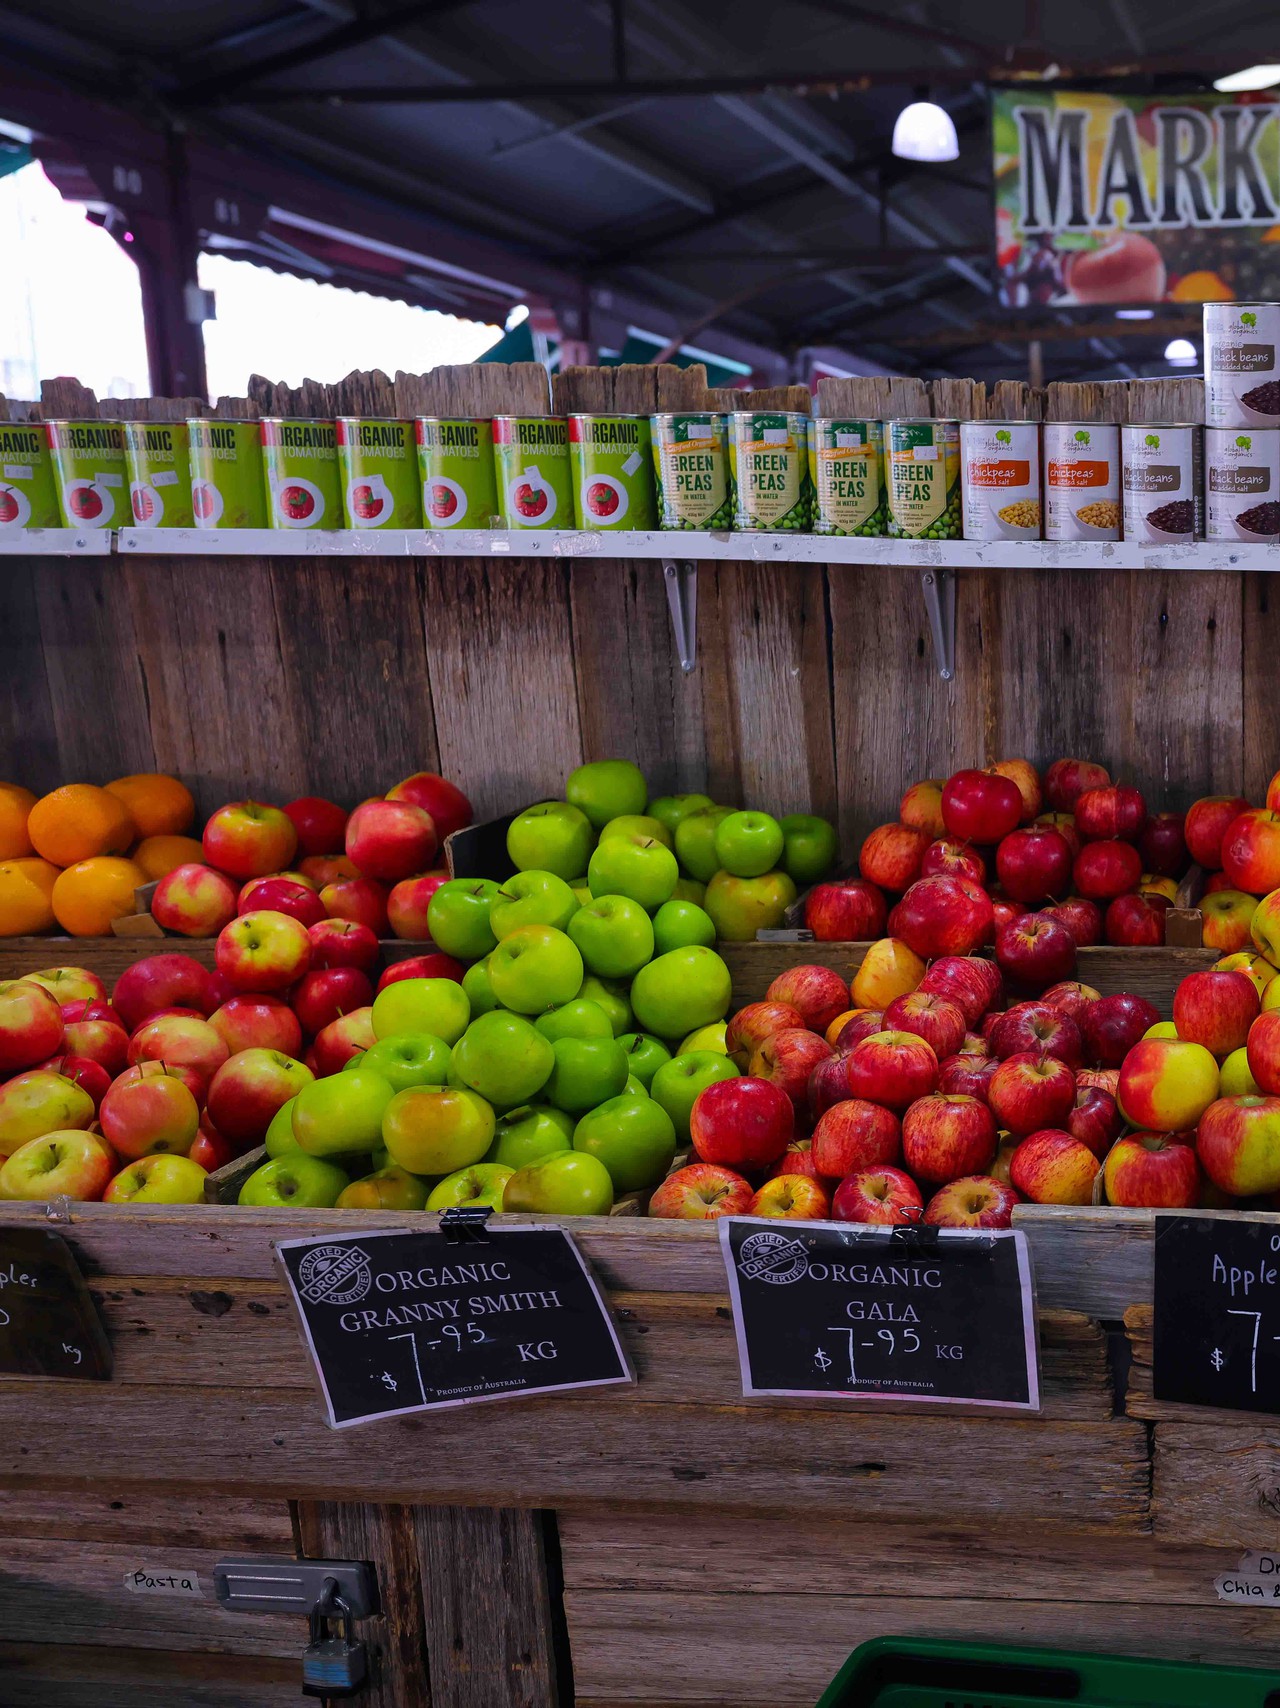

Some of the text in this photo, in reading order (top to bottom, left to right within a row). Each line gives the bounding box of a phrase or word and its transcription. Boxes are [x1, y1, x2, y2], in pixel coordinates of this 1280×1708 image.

[1240, 350, 1269, 362] beans
[60, 428, 120, 449] ORGANIC
[349, 426, 404, 447] ORGANIC
[425, 424, 478, 446] ORGANIC
[512, 424, 566, 445] ORGANIC
[585, 423, 638, 443] ORGANIC
[671, 455, 714, 471] GREEN
[746, 454, 788, 471] GREEN
[826, 462, 867, 478] GREEN
[750, 474, 785, 490] PEAS
[894, 465, 933, 481] GREEN
[1050, 466, 1094, 479] chickpeas
[1144, 471, 1173, 483] beans
[1235, 472, 1264, 484] beans
[676, 474, 712, 491] PEAS
[830, 481, 865, 498] PEAS
[897, 484, 931, 501] PEAS
[743, 1235, 783, 1258] CERTIFIED
[303, 1248, 341, 1280] CERTIFIED
[745, 1245, 801, 1273] ORGANIC
[308, 1252, 363, 1297] ORGANIC
[375, 1262, 511, 1293] ORGANIC
[808, 1263, 942, 1288] ORGANIC
[330, 1270, 369, 1302] CERTIFIED
[339, 1290, 563, 1332] GRANNY SMITH
[846, 1301, 921, 1323] GALA
[516, 1341, 558, 1363] KG
[935, 1344, 963, 1360] KG
[133, 1572, 194, 1591] Pasta
[1222, 1580, 1264, 1597] Chia
